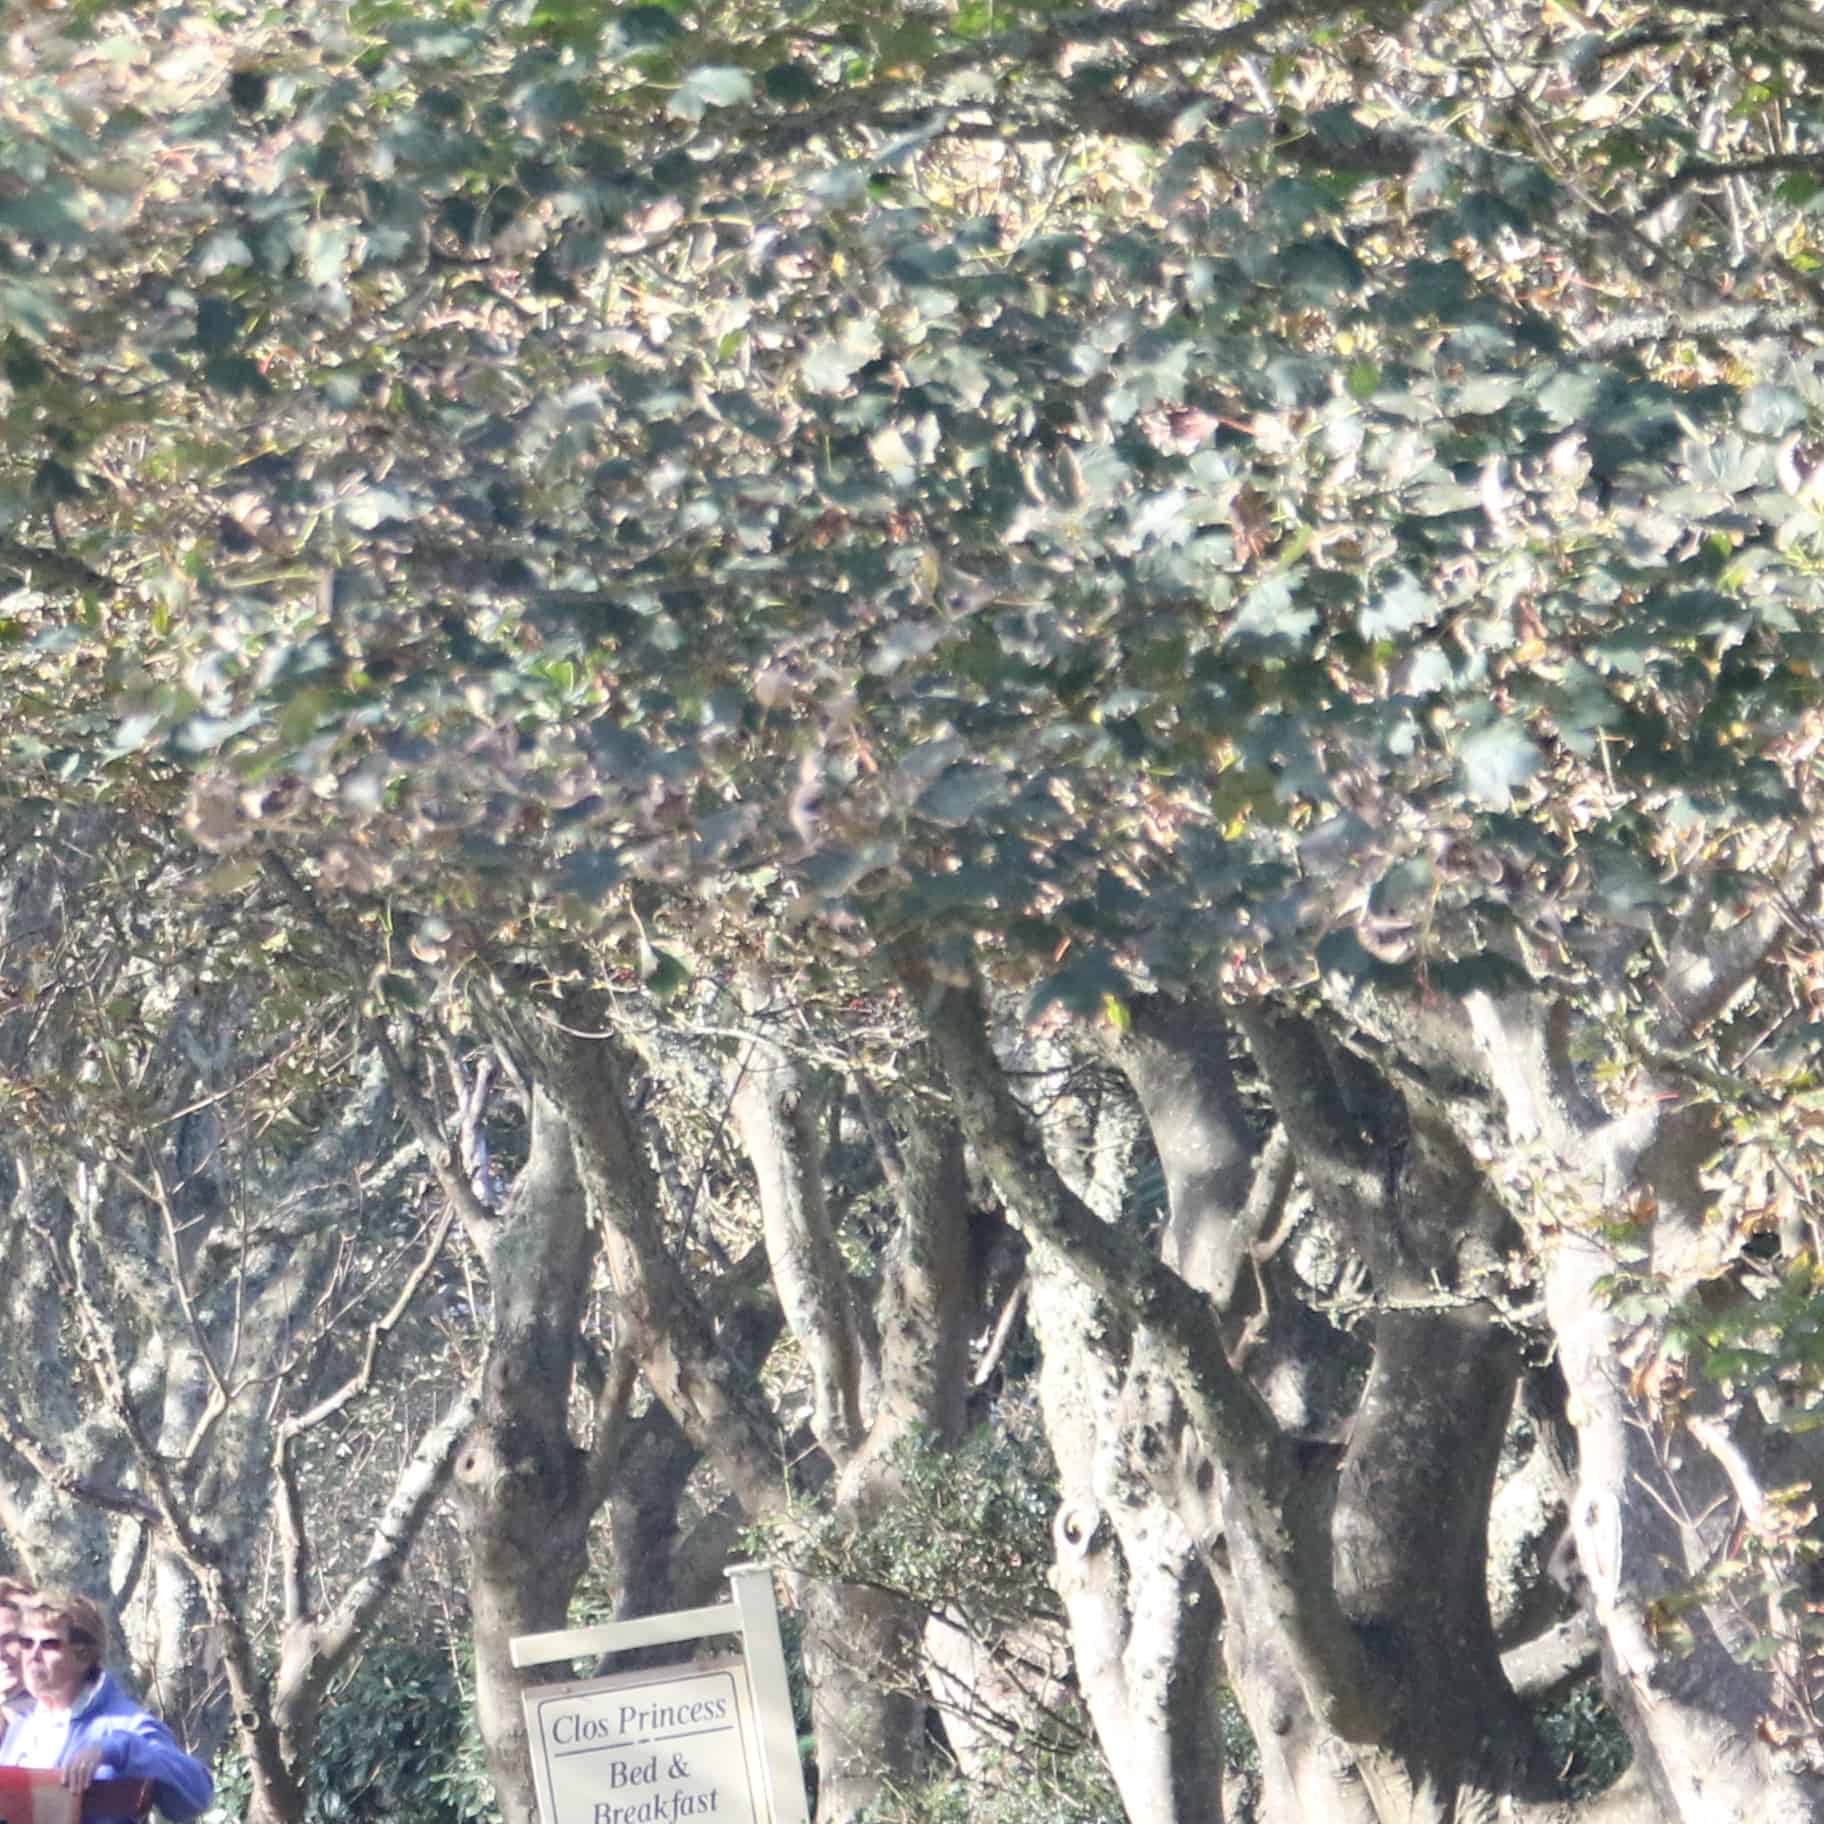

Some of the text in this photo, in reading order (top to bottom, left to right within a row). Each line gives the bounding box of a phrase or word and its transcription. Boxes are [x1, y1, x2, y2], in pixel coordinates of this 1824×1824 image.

[552, 1698, 727, 1744] Clos Princess
[609, 1752, 690, 1789] Bed &
